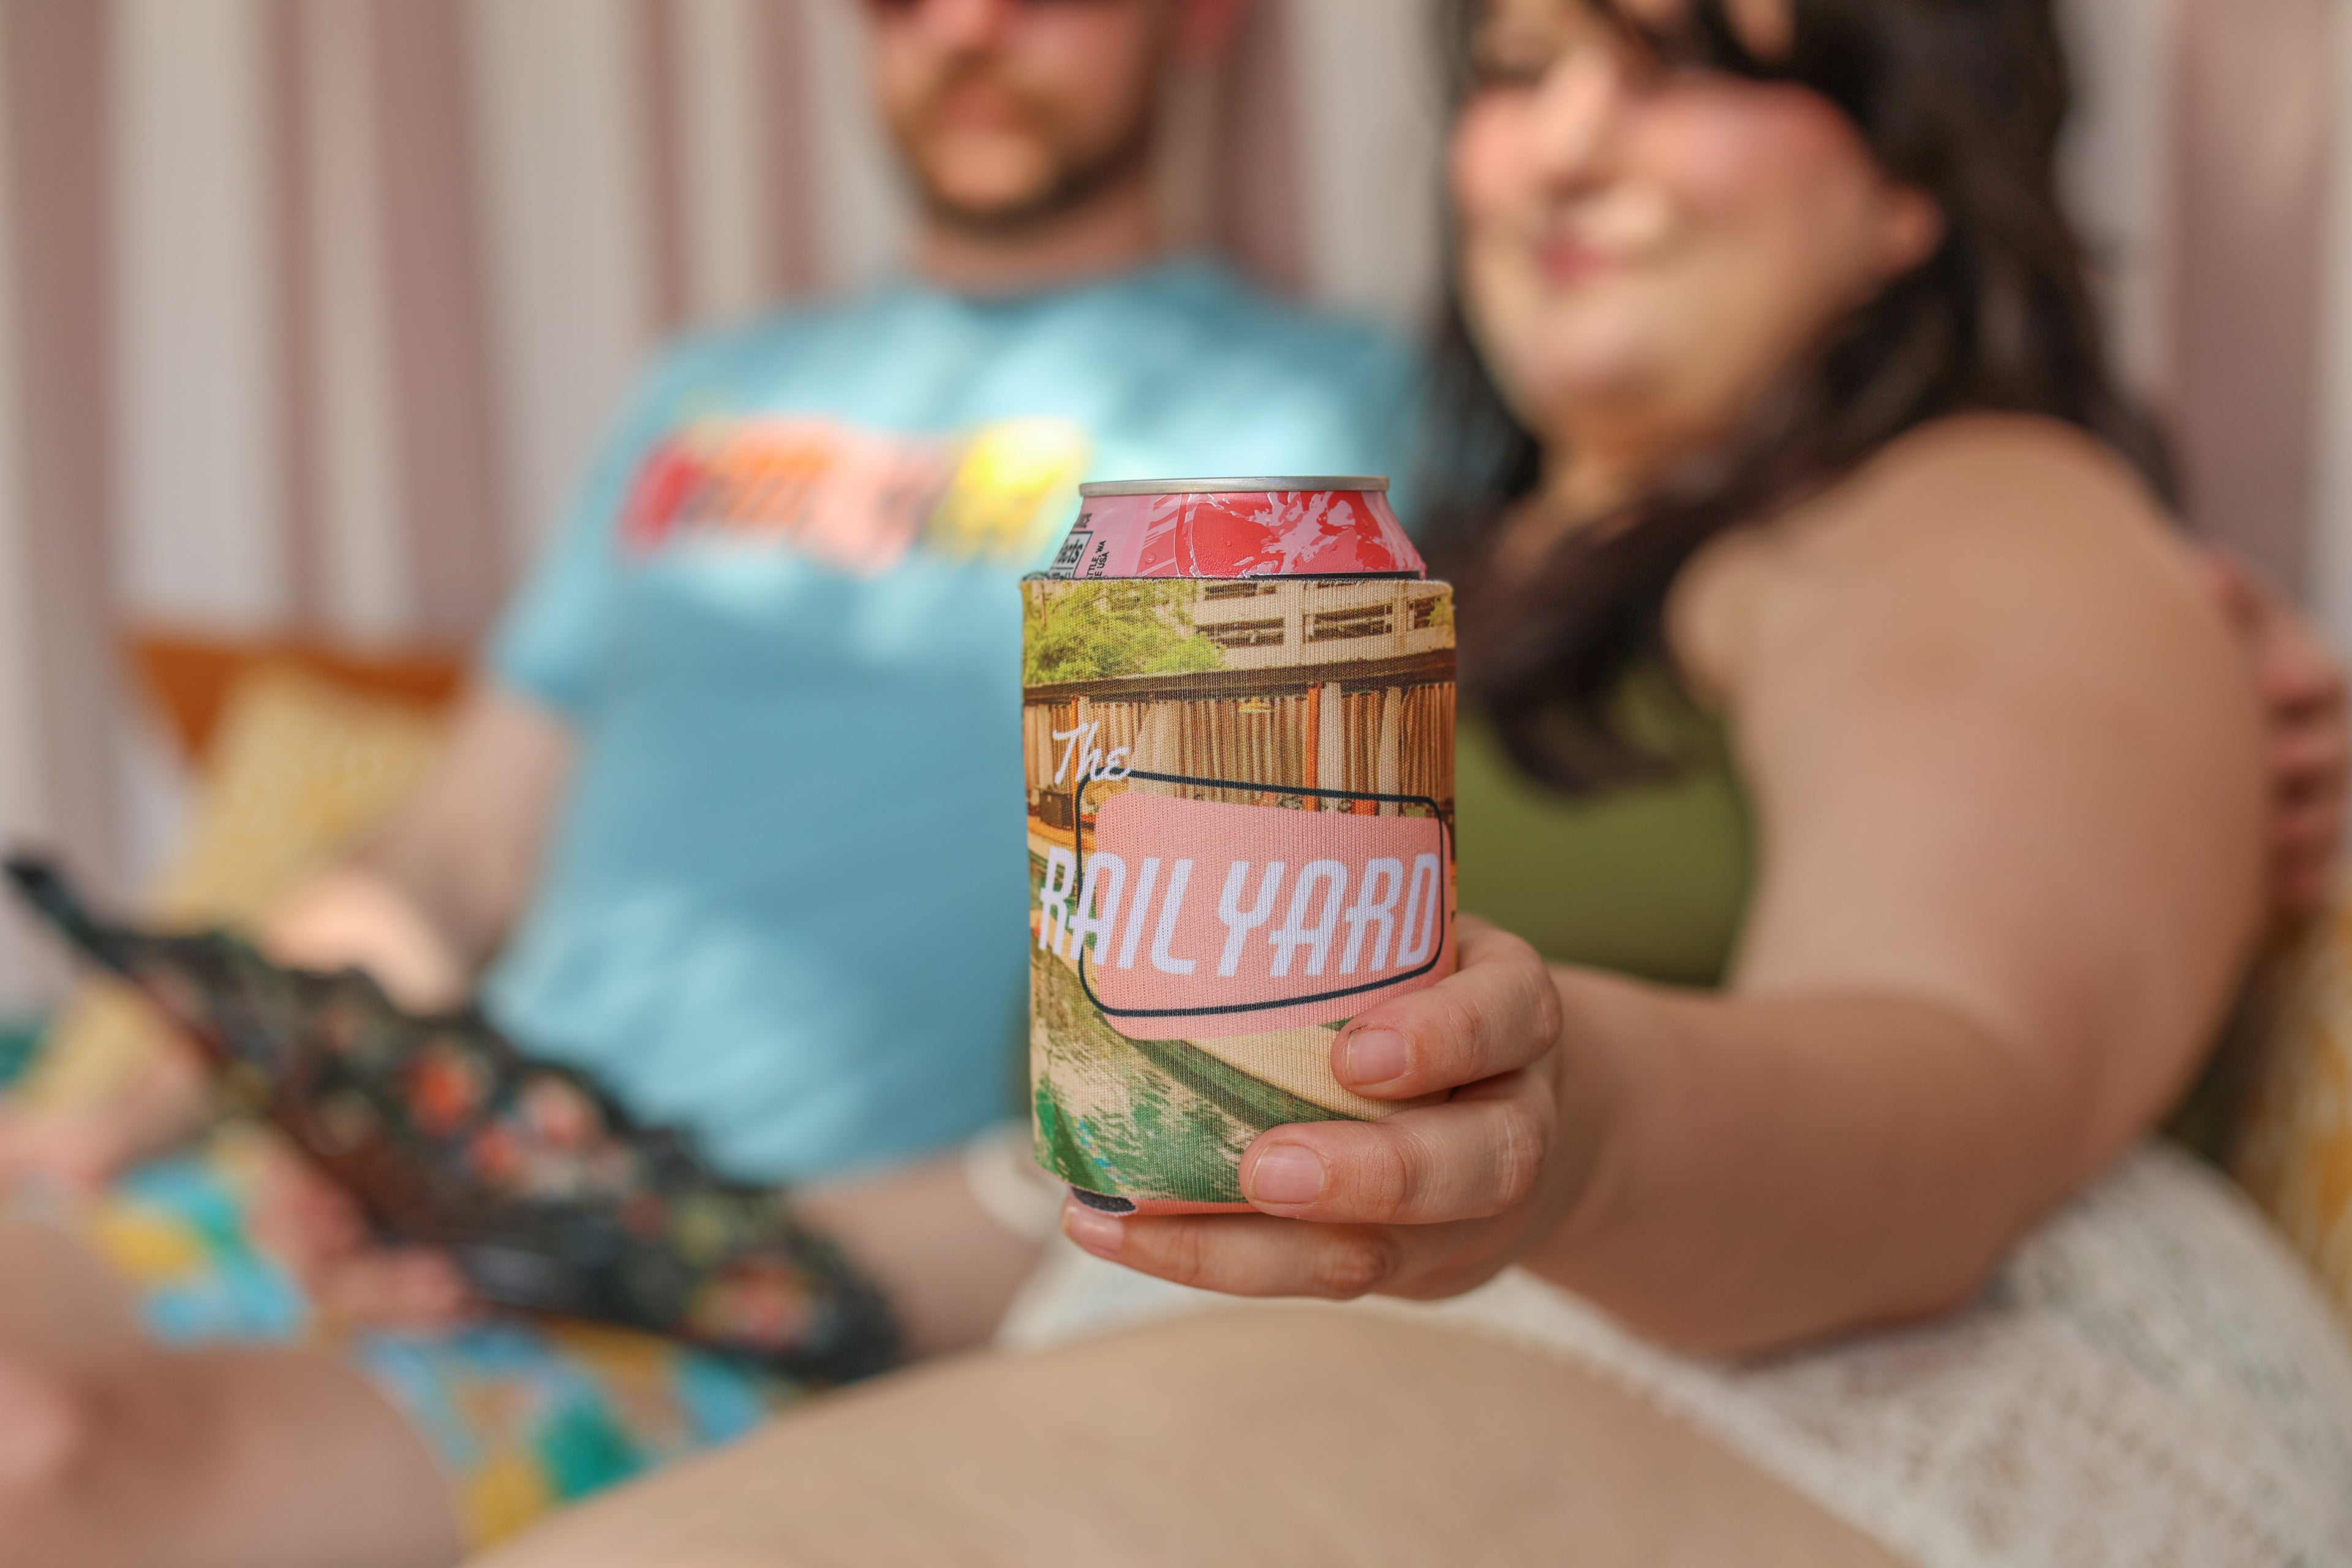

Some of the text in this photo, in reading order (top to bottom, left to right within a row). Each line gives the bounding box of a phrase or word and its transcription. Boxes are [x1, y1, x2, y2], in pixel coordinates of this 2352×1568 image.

[1095, 540, 1106, 554] WA
[1096, 551, 1109, 568] USA
[1052, 721, 1131, 785] The
[1038, 846, 1439, 977] RAILYARD
